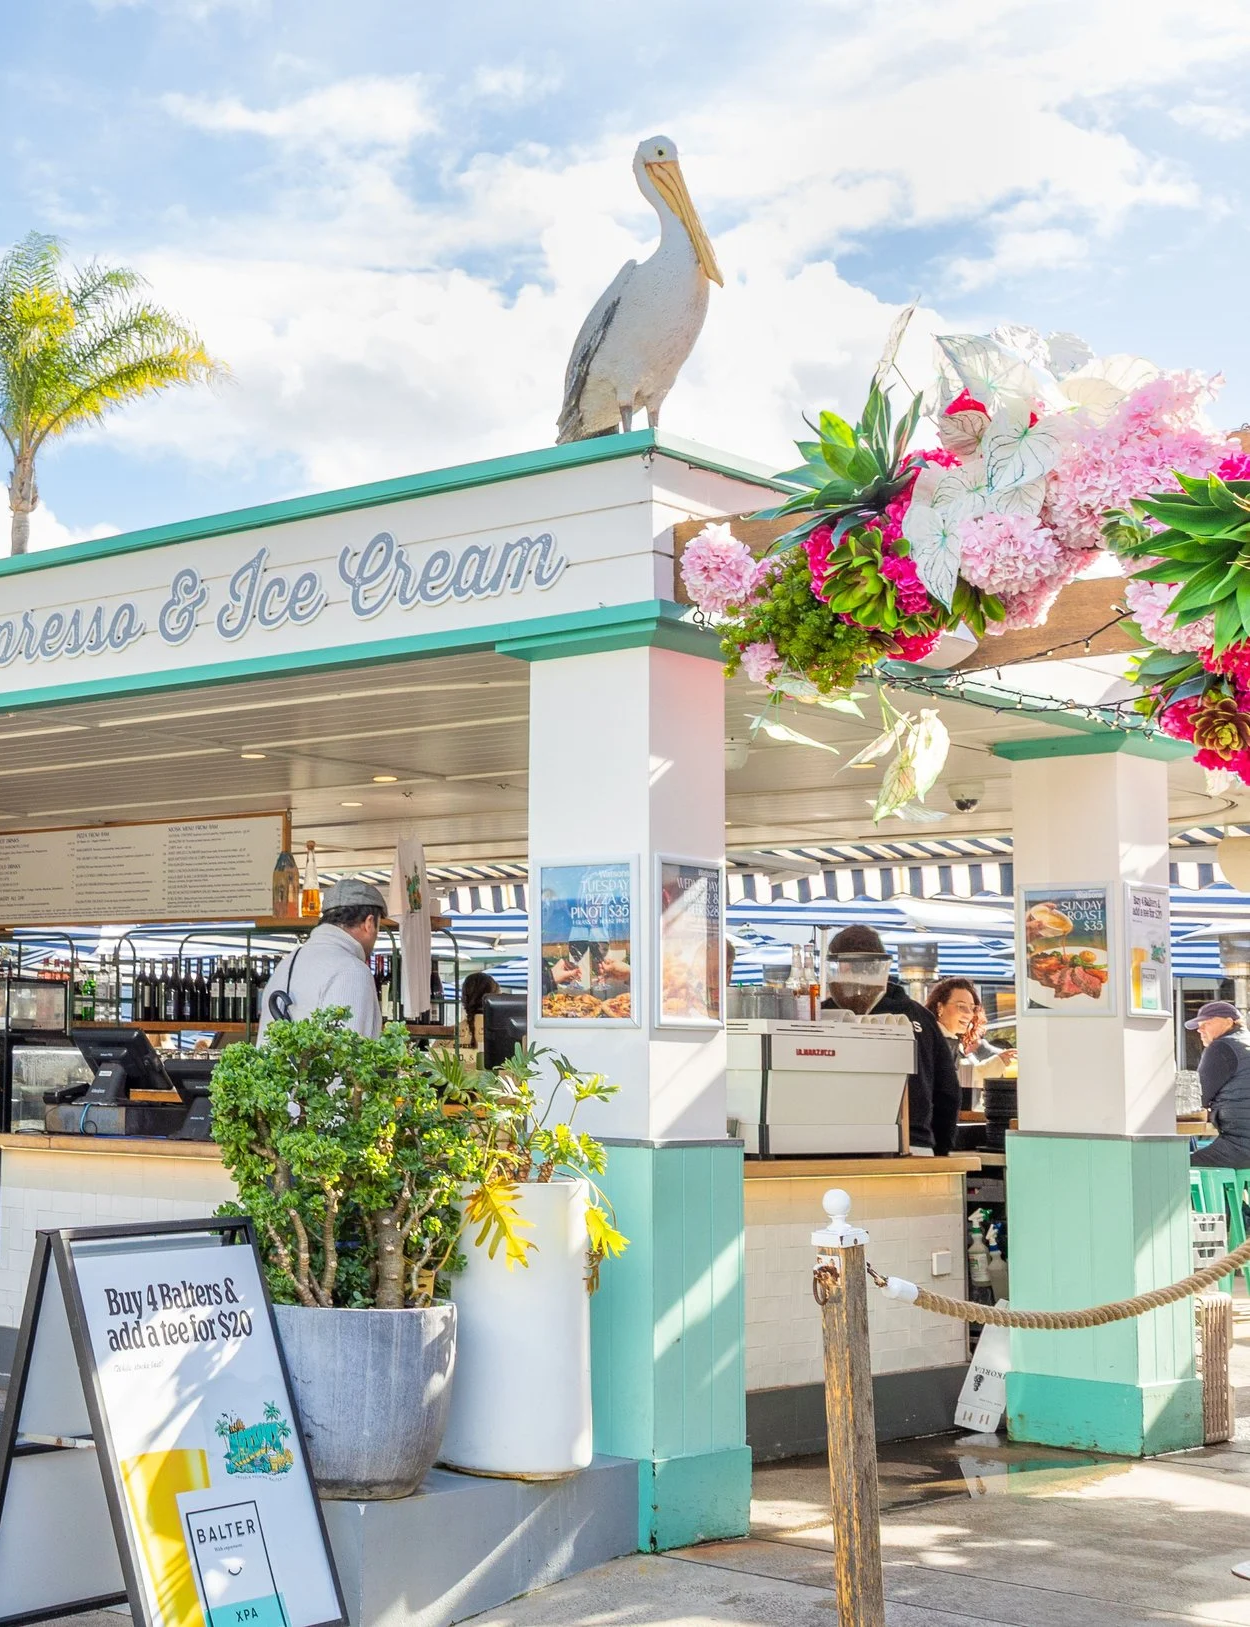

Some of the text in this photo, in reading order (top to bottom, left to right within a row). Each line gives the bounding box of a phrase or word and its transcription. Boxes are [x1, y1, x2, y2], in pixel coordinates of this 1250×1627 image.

[159, 567, 208, 646] &
[216, 546, 326, 641] Ice
[339, 531, 568, 620] Cream
[581, 879, 630, 892] TUESDAY
[586, 893, 616, 905] PIZZA
[1062, 901, 1102, 911] SUNDAY
[571, 905, 629, 919] PINOT $35
[1068, 910, 1103, 921] ROAST
[1084, 921, 1104, 931] $35
[105, 1277, 239, 1319] Buy 4 Balters &
[107, 1310, 253, 1352] add a tee for $20
[196, 1519, 257, 1544] BALTER
[235, 1607, 259, 1622] XPA
